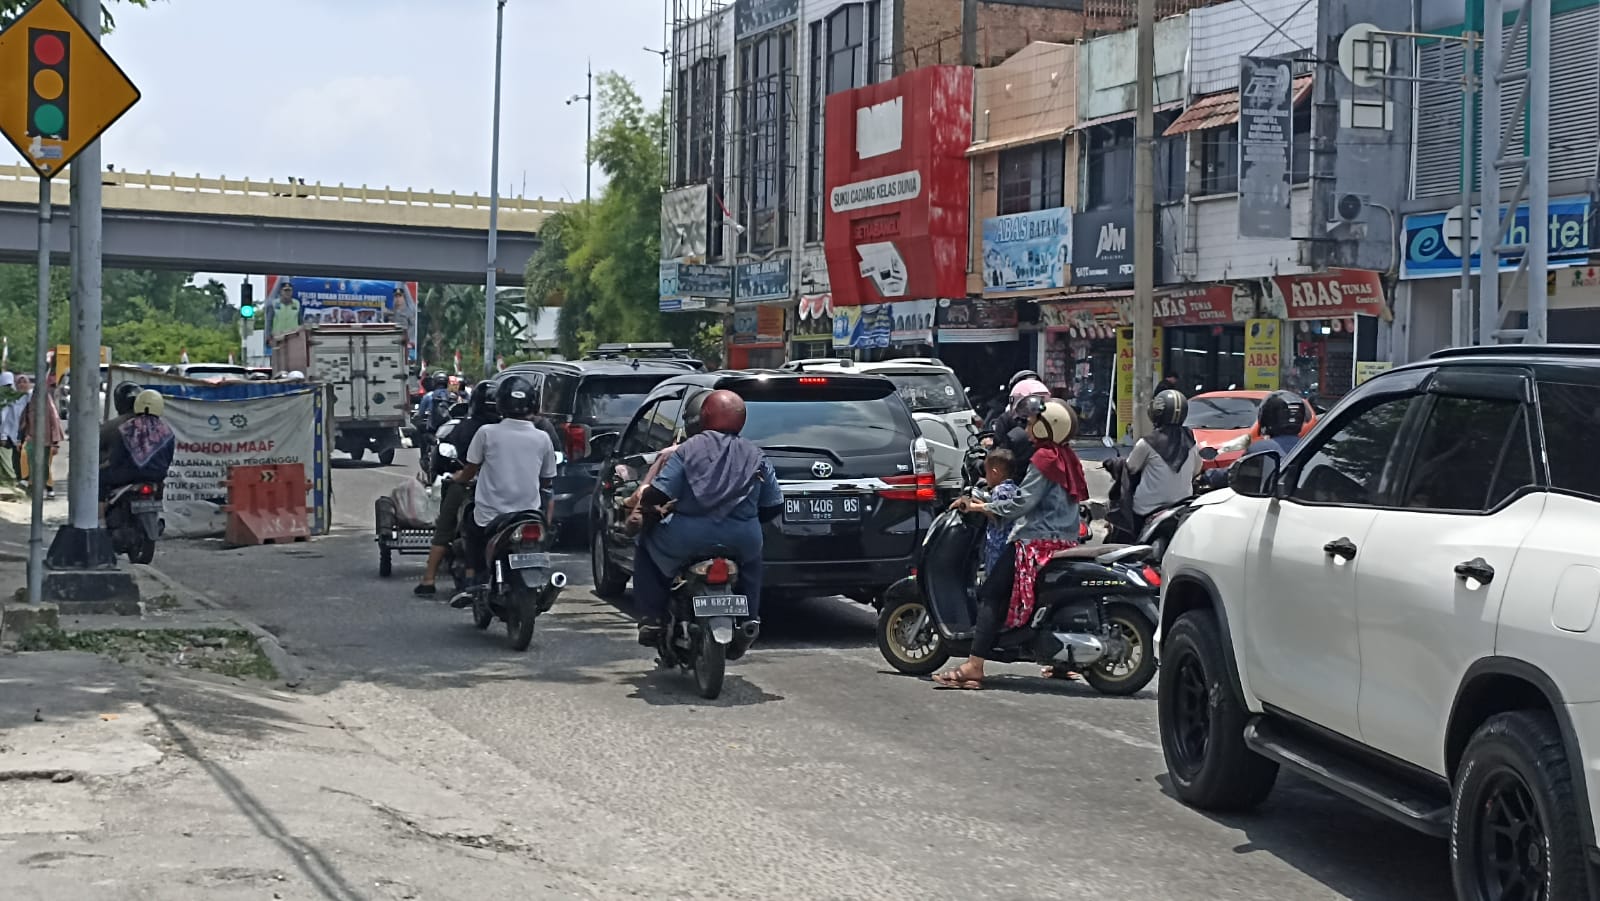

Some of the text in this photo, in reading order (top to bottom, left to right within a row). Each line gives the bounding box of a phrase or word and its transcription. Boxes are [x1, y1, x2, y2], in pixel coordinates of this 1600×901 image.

[833, 178, 917, 208] SUKU CADANG KELAS DUNIA
[996, 216, 1060, 243] ABAS BATAM
[1509, 204, 1589, 248] htel
[1291, 280, 1373, 308] ABAS TUNAS
[1189, 301, 1213, 311] TUNAS
[1119, 347, 1160, 359] AS
[1248, 353, 1278, 367] ABAS
[176, 440, 275, 454] MOHON MAAF
[214, 456, 241, 466] ANDA
[184, 470, 219, 478] GALIAN
[166, 491, 191, 501] LEBIH
[786, 499, 800, 513] BM
[809, 499, 833, 513] 1406
[695, 598, 707, 608] BM
